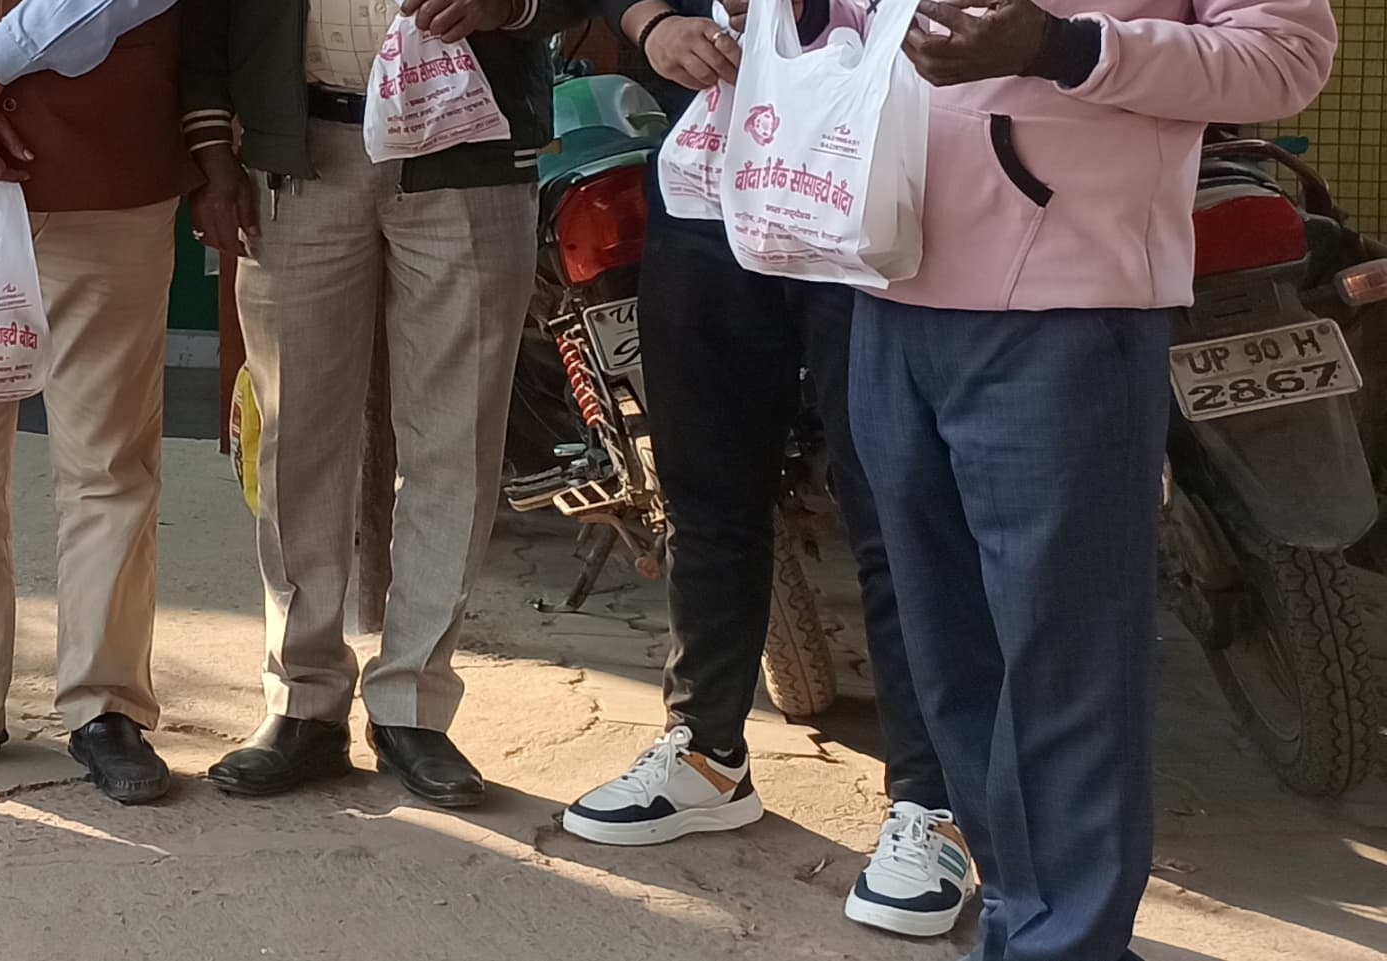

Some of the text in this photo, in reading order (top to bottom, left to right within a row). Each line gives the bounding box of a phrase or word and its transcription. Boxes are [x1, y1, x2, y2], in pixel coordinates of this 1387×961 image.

[1186, 329, 1322, 374] UP 90 H
[1187, 360, 1341, 412] 2867
